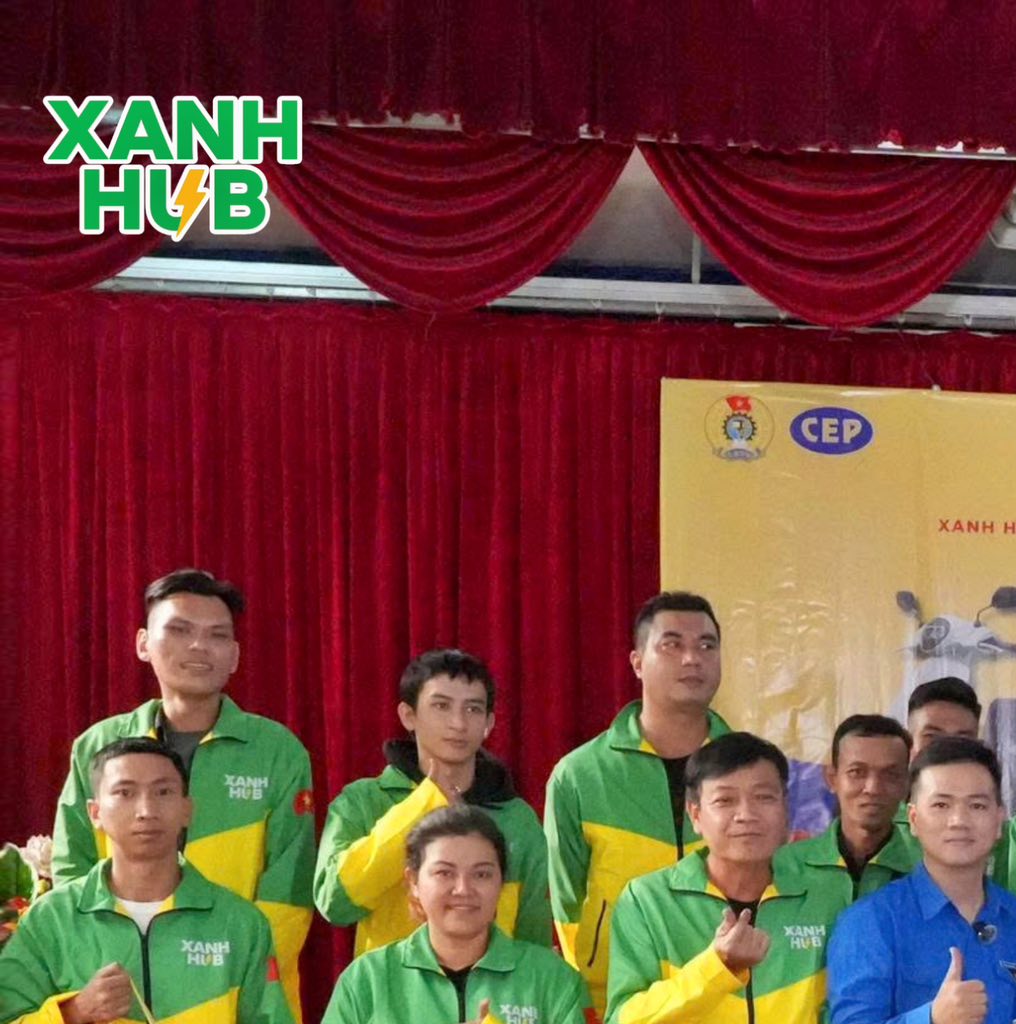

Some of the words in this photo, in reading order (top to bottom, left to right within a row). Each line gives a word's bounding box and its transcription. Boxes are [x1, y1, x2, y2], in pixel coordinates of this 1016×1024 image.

[801, 417, 862, 444] CEP
[938, 519, 995, 534] XANH
[224, 774, 269, 788] XANH
[229, 786, 263, 800] HUB
[783, 925, 826, 937] XANH
[181, 939, 230, 954] XANH
[790, 936, 822, 950] HUB
[187, 953, 224, 966] HUB
